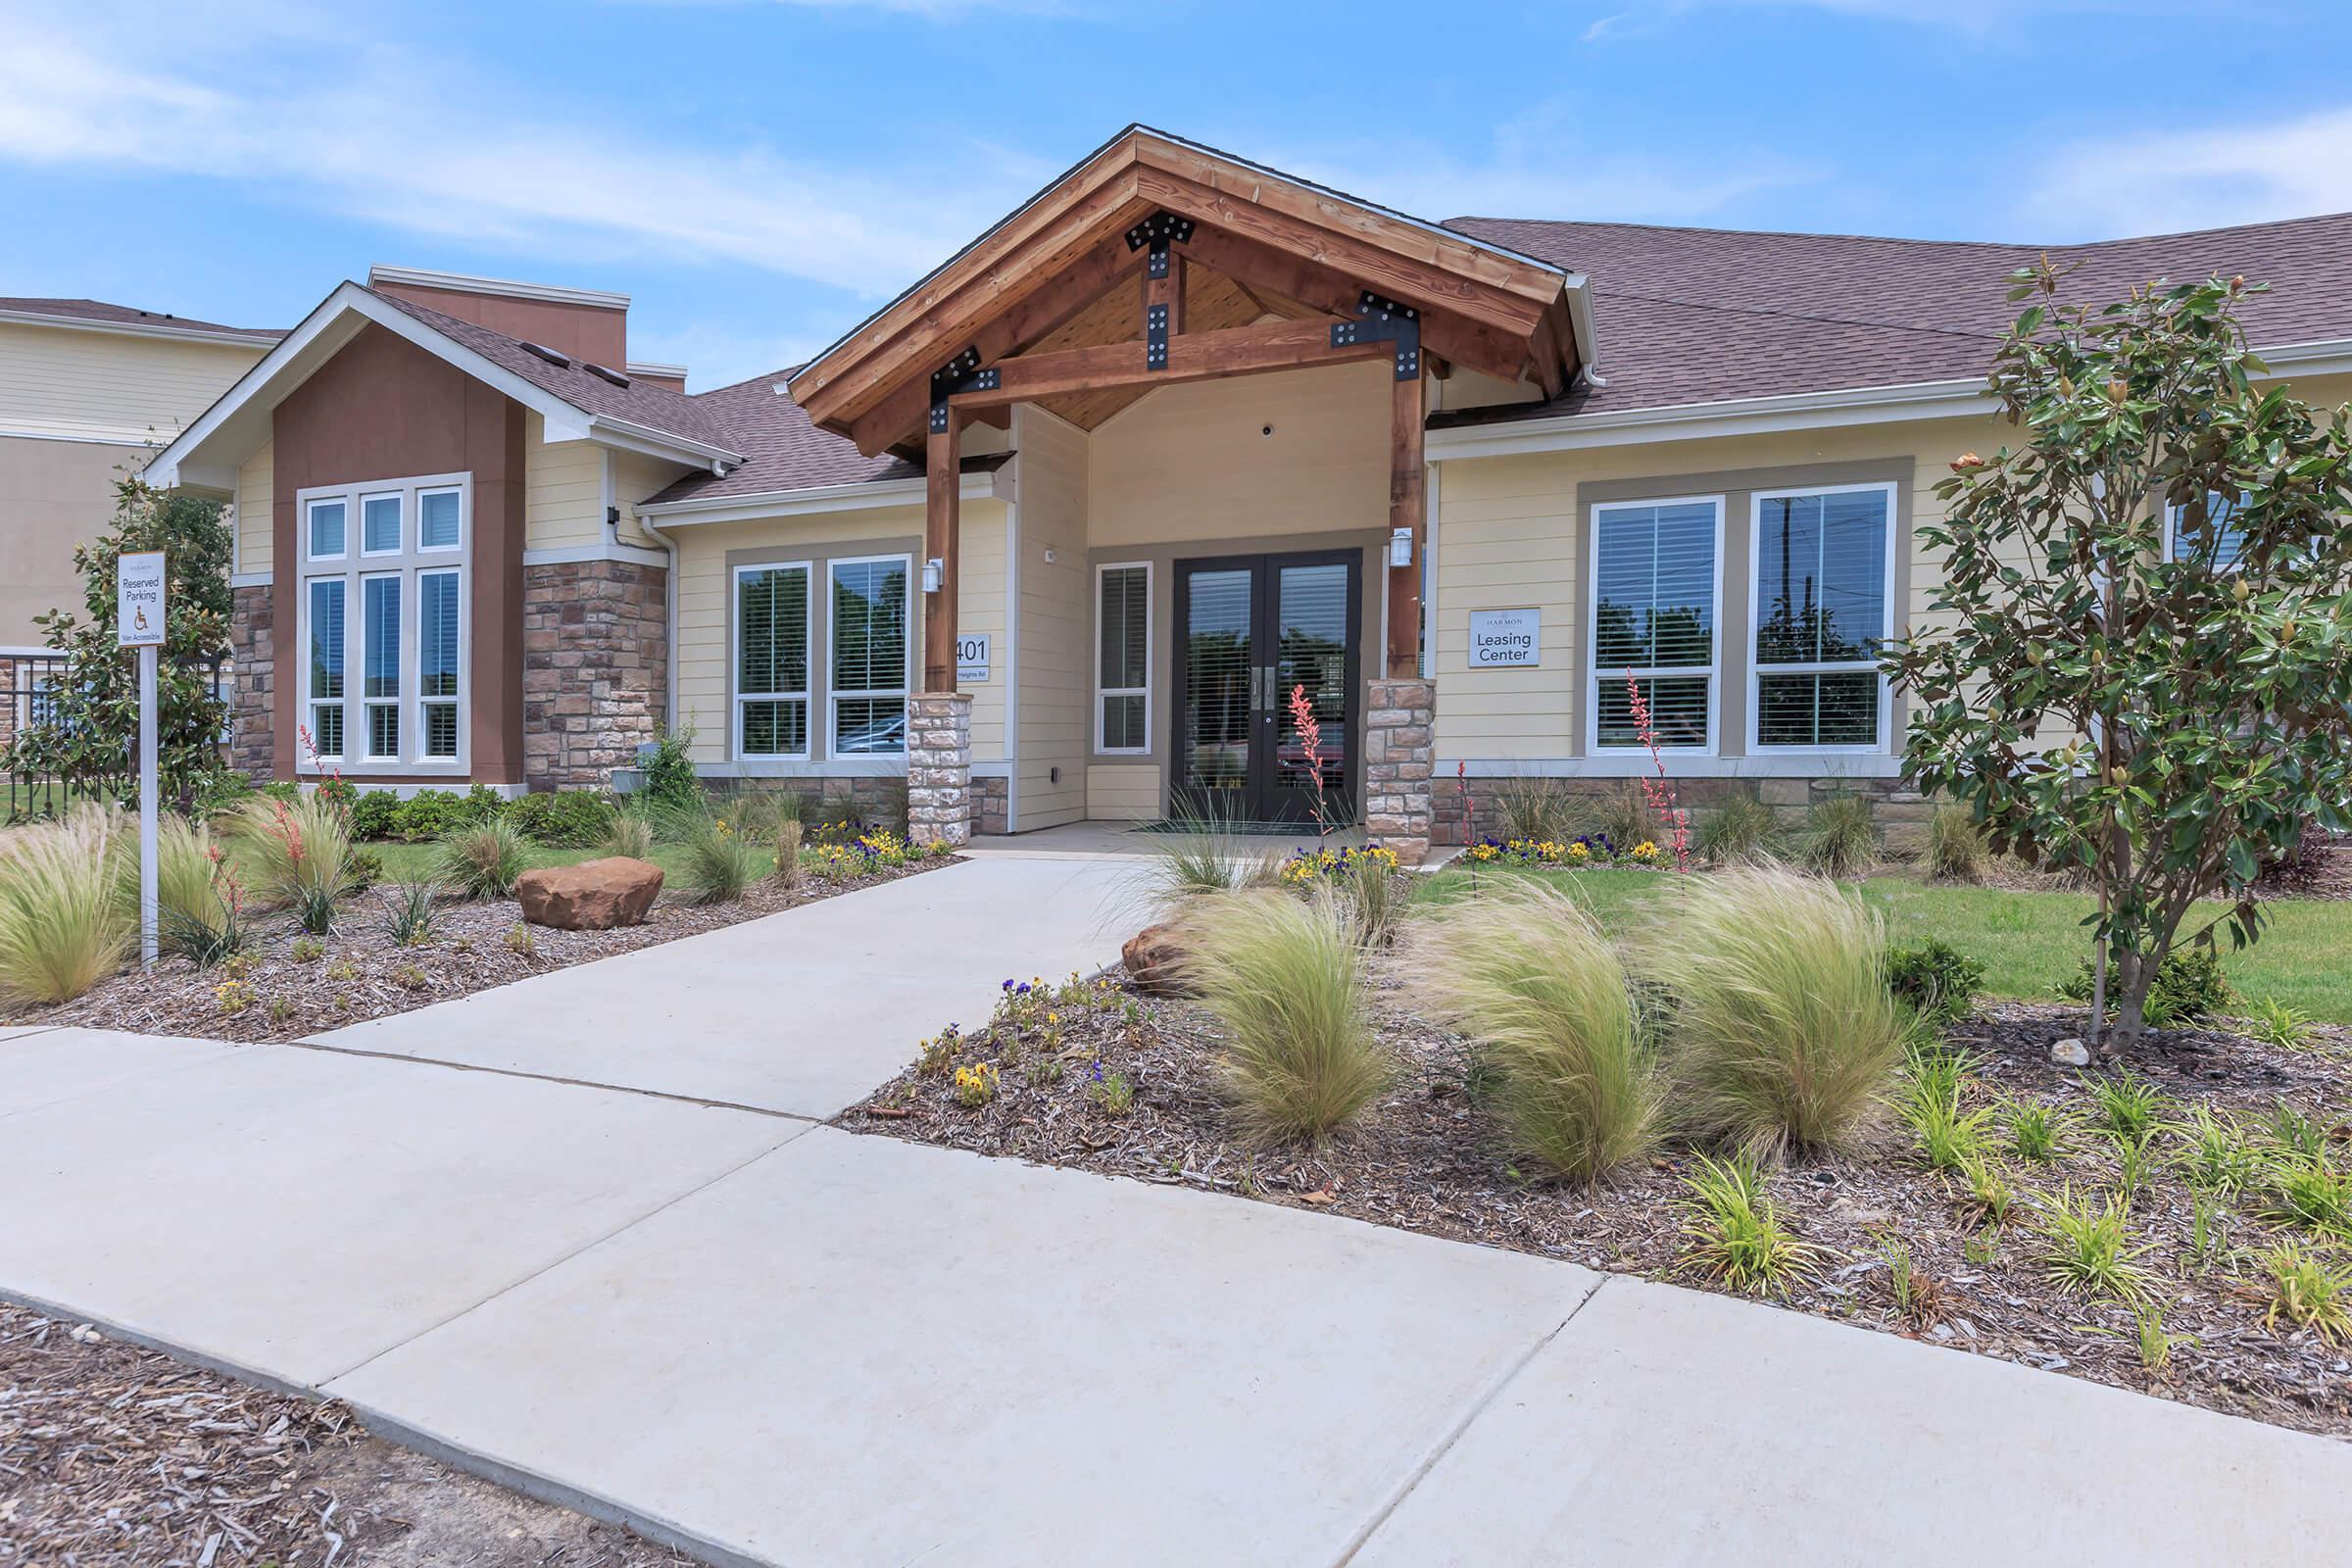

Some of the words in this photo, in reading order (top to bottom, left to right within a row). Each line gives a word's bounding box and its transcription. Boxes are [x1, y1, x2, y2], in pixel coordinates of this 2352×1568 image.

[122, 575, 159, 588] Reserved
[126, 590, 157, 603] Parking
[133, 632, 161, 641] Accessible
[1477, 632, 1531, 648] Leasing
[1479, 648, 1529, 662] Center
